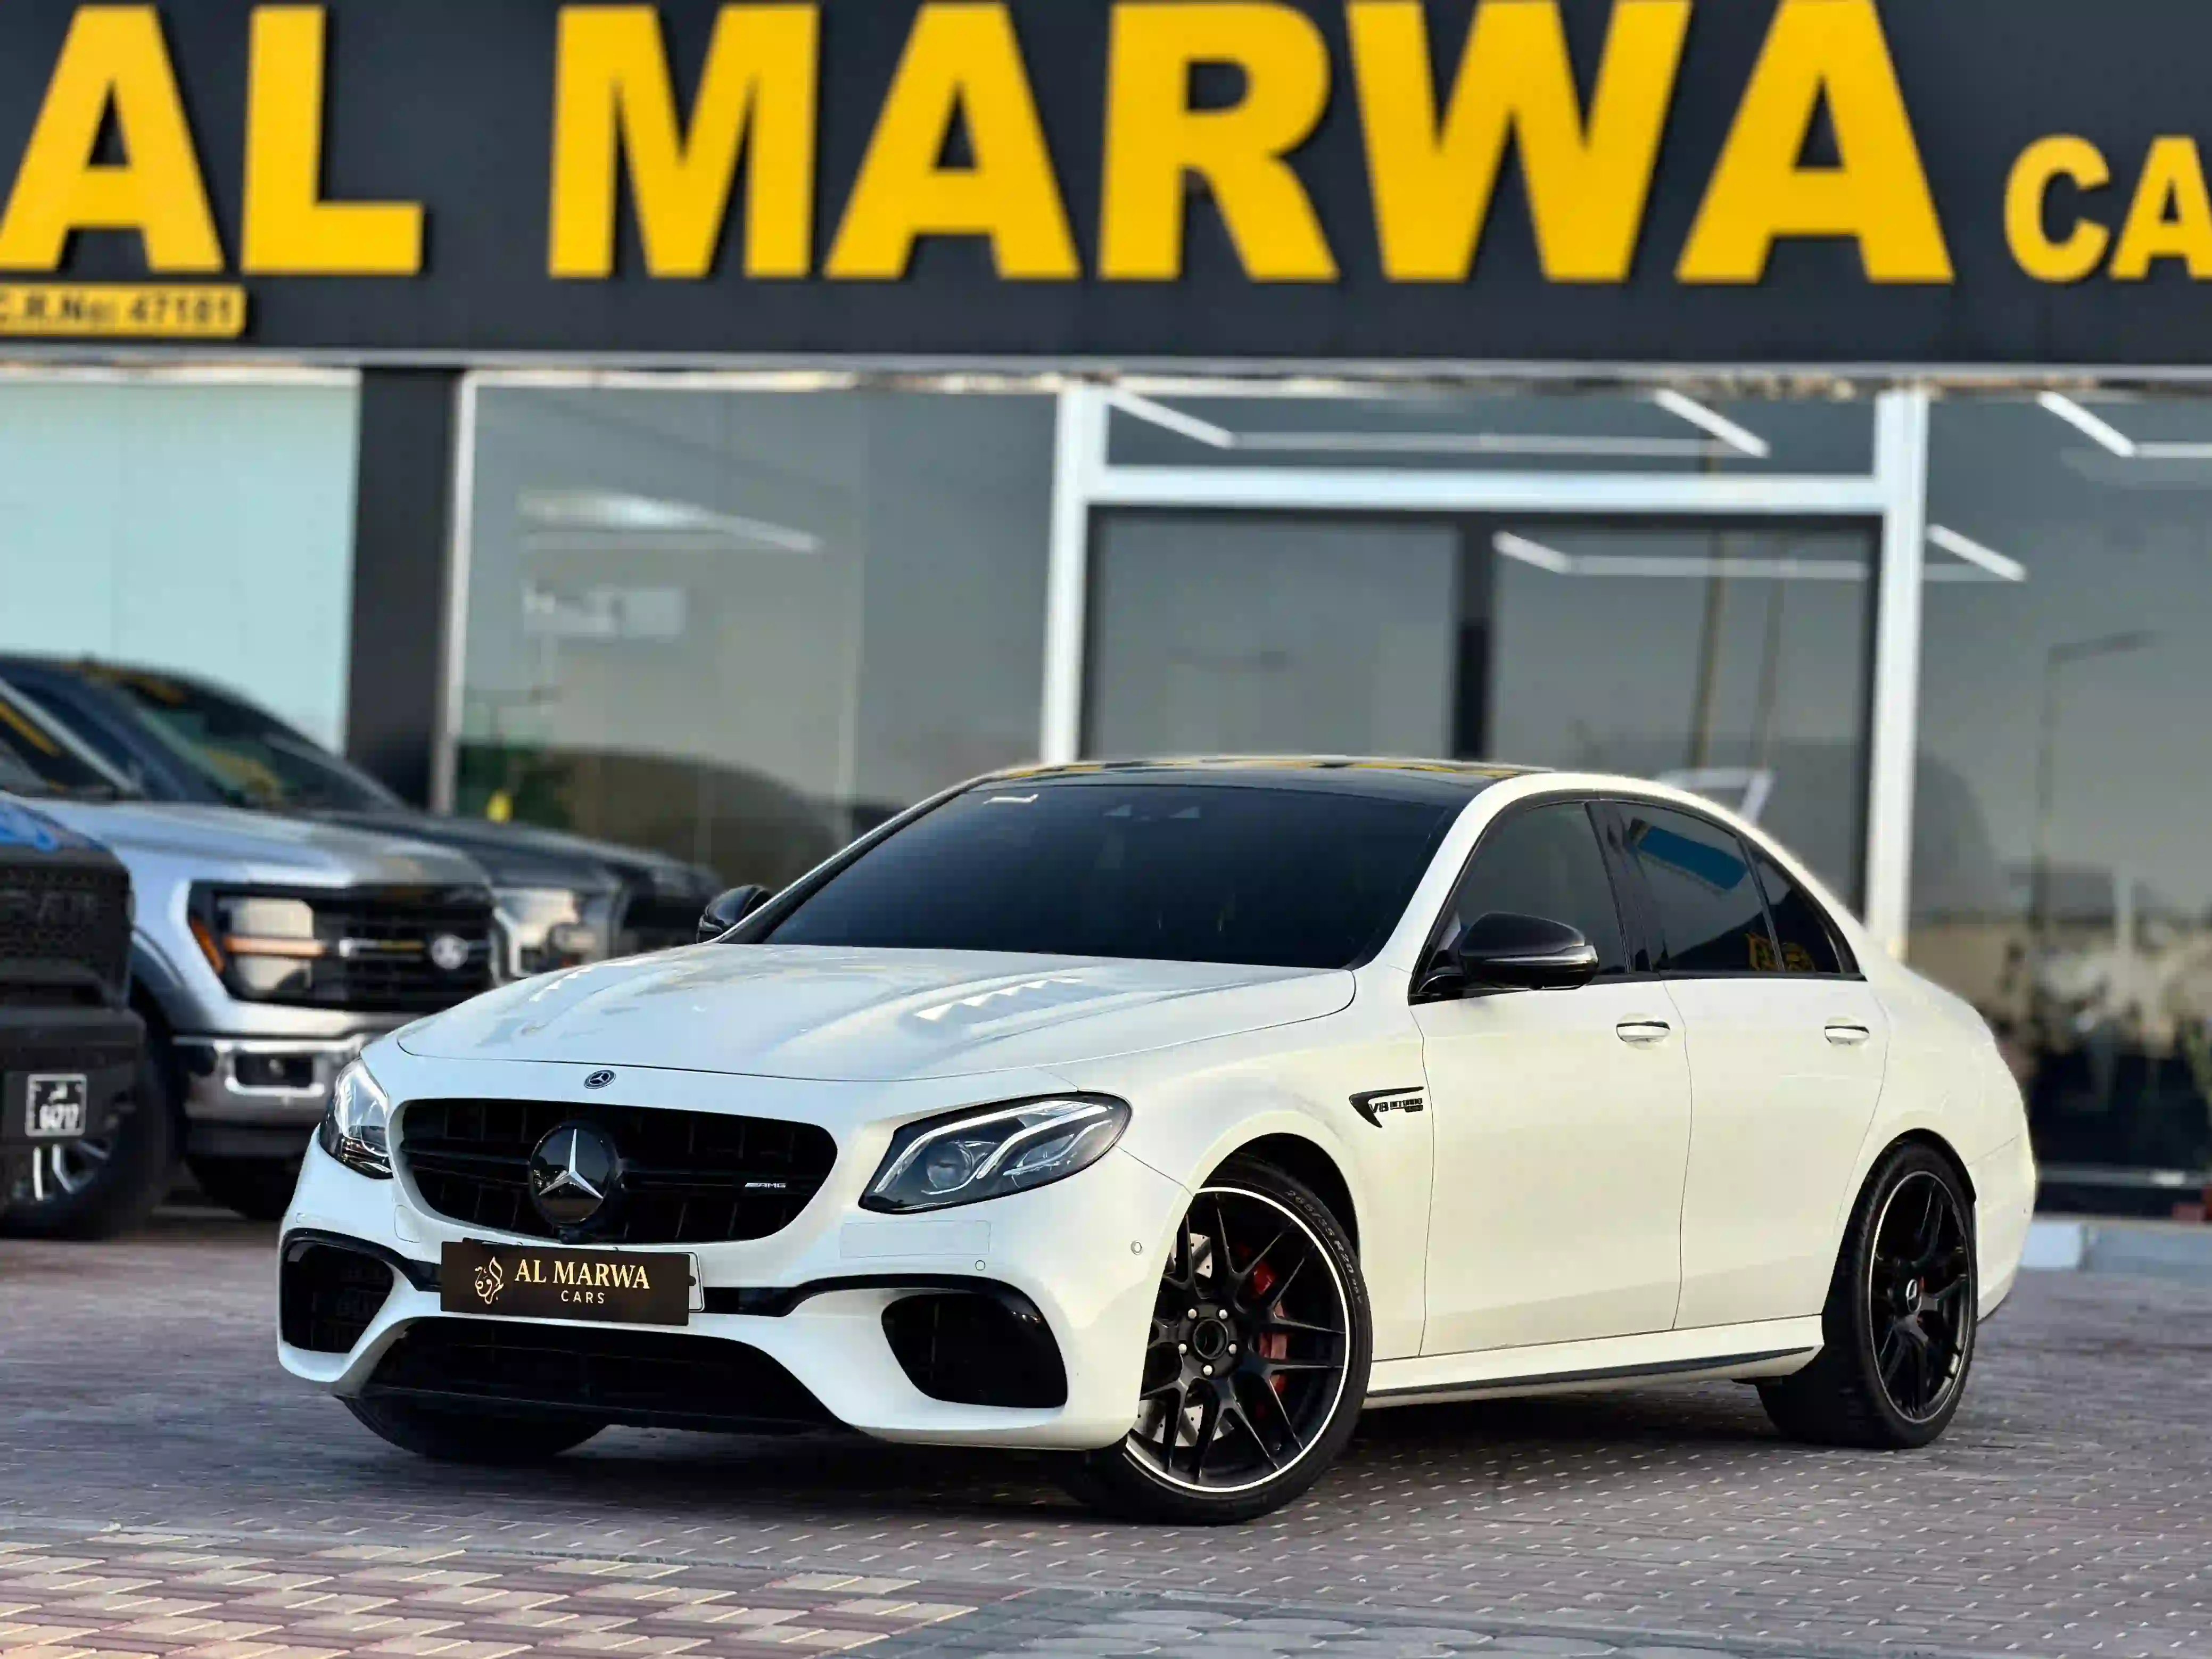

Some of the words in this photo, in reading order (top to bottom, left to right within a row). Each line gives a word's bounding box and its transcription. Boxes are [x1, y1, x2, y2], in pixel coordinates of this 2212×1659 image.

[0, 5, 424, 275] AL
[548, 0, 1954, 283] MARWA
[1368, 1102, 1389, 1113] V8
[514, 1258, 547, 1284] AL
[552, 1260, 650, 1290] MARWA
[560, 1290, 605, 1304] CARS
